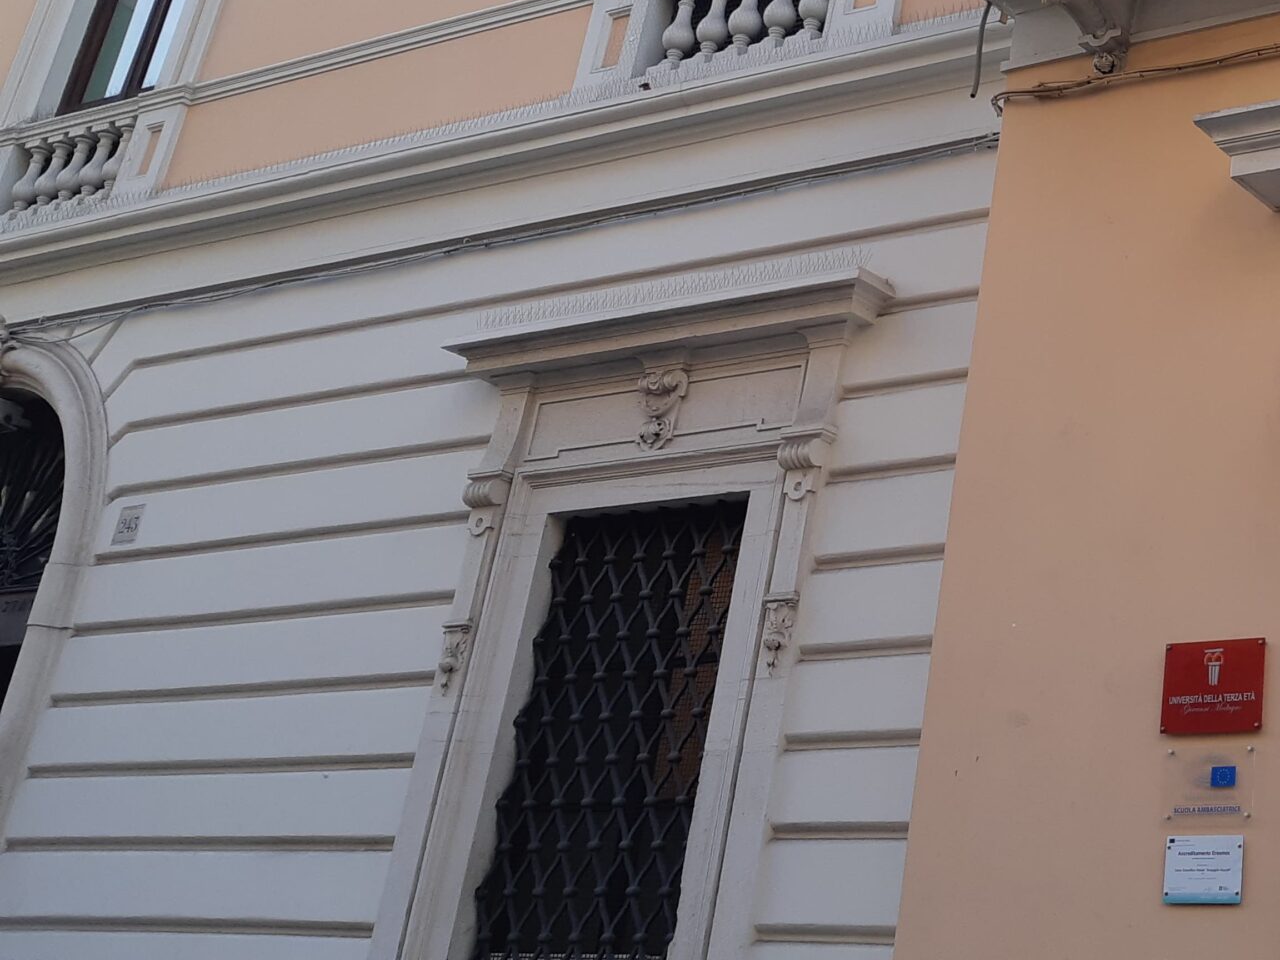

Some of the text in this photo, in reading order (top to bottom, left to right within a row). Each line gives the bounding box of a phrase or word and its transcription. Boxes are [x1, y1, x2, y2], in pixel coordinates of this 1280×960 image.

[1169, 691, 1255, 704] UNIVERSITÀ DELLA TERZA ETÀ
